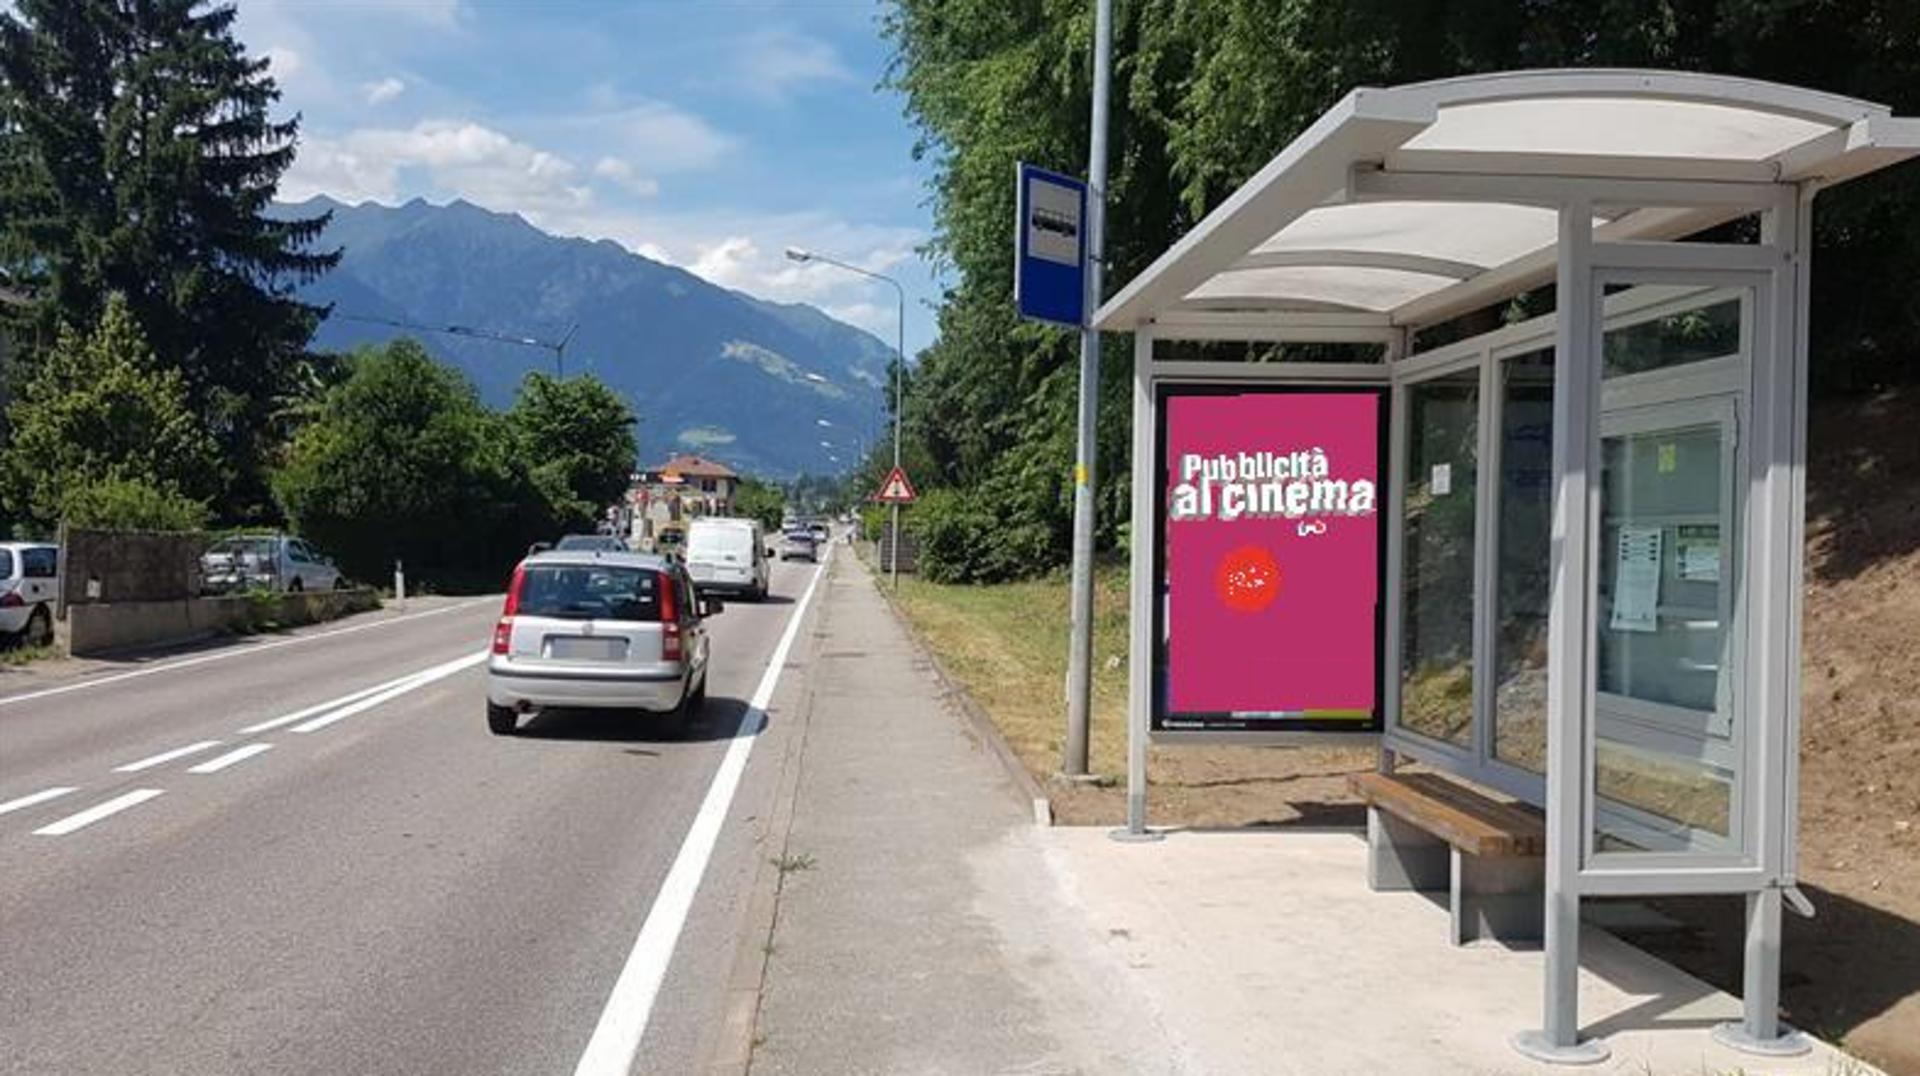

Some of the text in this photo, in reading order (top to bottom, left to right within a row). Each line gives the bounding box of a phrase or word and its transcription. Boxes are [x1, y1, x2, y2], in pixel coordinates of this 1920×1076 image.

[1183, 447, 1328, 481] Pubblicità
[1173, 475, 1376, 519] al cinema
